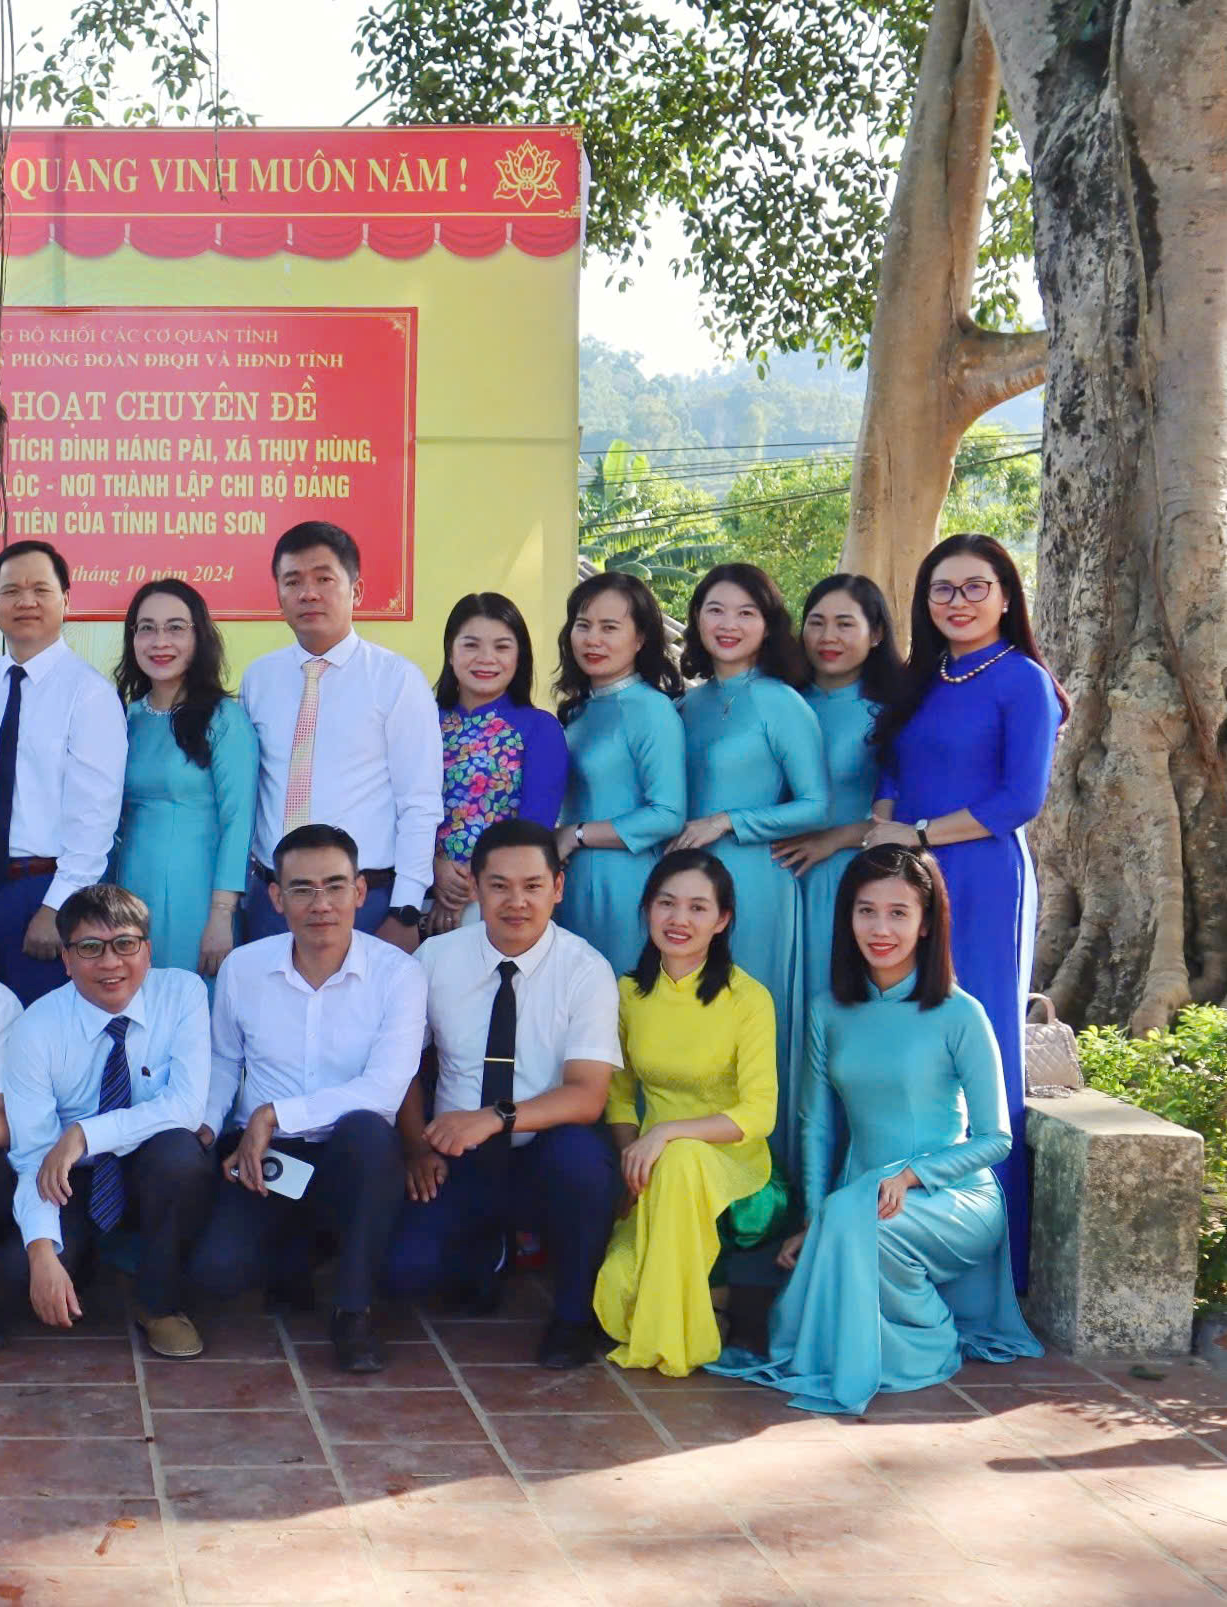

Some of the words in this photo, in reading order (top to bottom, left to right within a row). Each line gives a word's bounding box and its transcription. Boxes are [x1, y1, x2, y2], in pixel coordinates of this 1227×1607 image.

[10, 157, 139, 200] QUANG
[149, 157, 238, 193] VINH
[248, 149, 358, 193] MUÔN
[366, 151, 449, 192] NĂM
[50, 324, 95, 343] KHỐI
[143, 327, 171, 343] CƠ
[174, 328, 229, 345] QUAN
[11, 350, 79, 368] PHÒNG
[144, 352, 200, 369] ĐBQH
[206, 350, 231, 368] VÀ
[237, 353, 292, 368] HĐND
[11, 391, 107, 429] HOẠT
[115, 381, 260, 421] CHUYÊN
[270, 375, 317, 422] ĐỀ
[9, 433, 53, 461] TÍCH
[59, 433, 109, 461] ĐÌNH
[115, 433, 172, 462] HÁNG
[178, 433, 218, 464] PÀI,
[225, 434, 253, 462] XÃ
[258, 438, 309, 466] THỤY
[315, 434, 378, 465] HÙNG,
[60, 473, 96, 497] NƠI
[103, 470, 169, 497] THÀNH
[175, 470, 214, 502] LẬP
[220, 474, 254, 497] CHI
[260, 470, 287, 502] BỘ
[294, 466, 350, 498] ĐẢNG
[13, 506, 58, 534] TIÊN
[64, 502, 106, 535] CỦA
[111, 504, 158, 534] TỈNH
[164, 511, 217, 539] LẠNG
[224, 509, 266, 534] SƠN
[72, 565, 120, 586] tháng
[126, 565, 147, 582] 10
[192, 565, 235, 582] 2024
